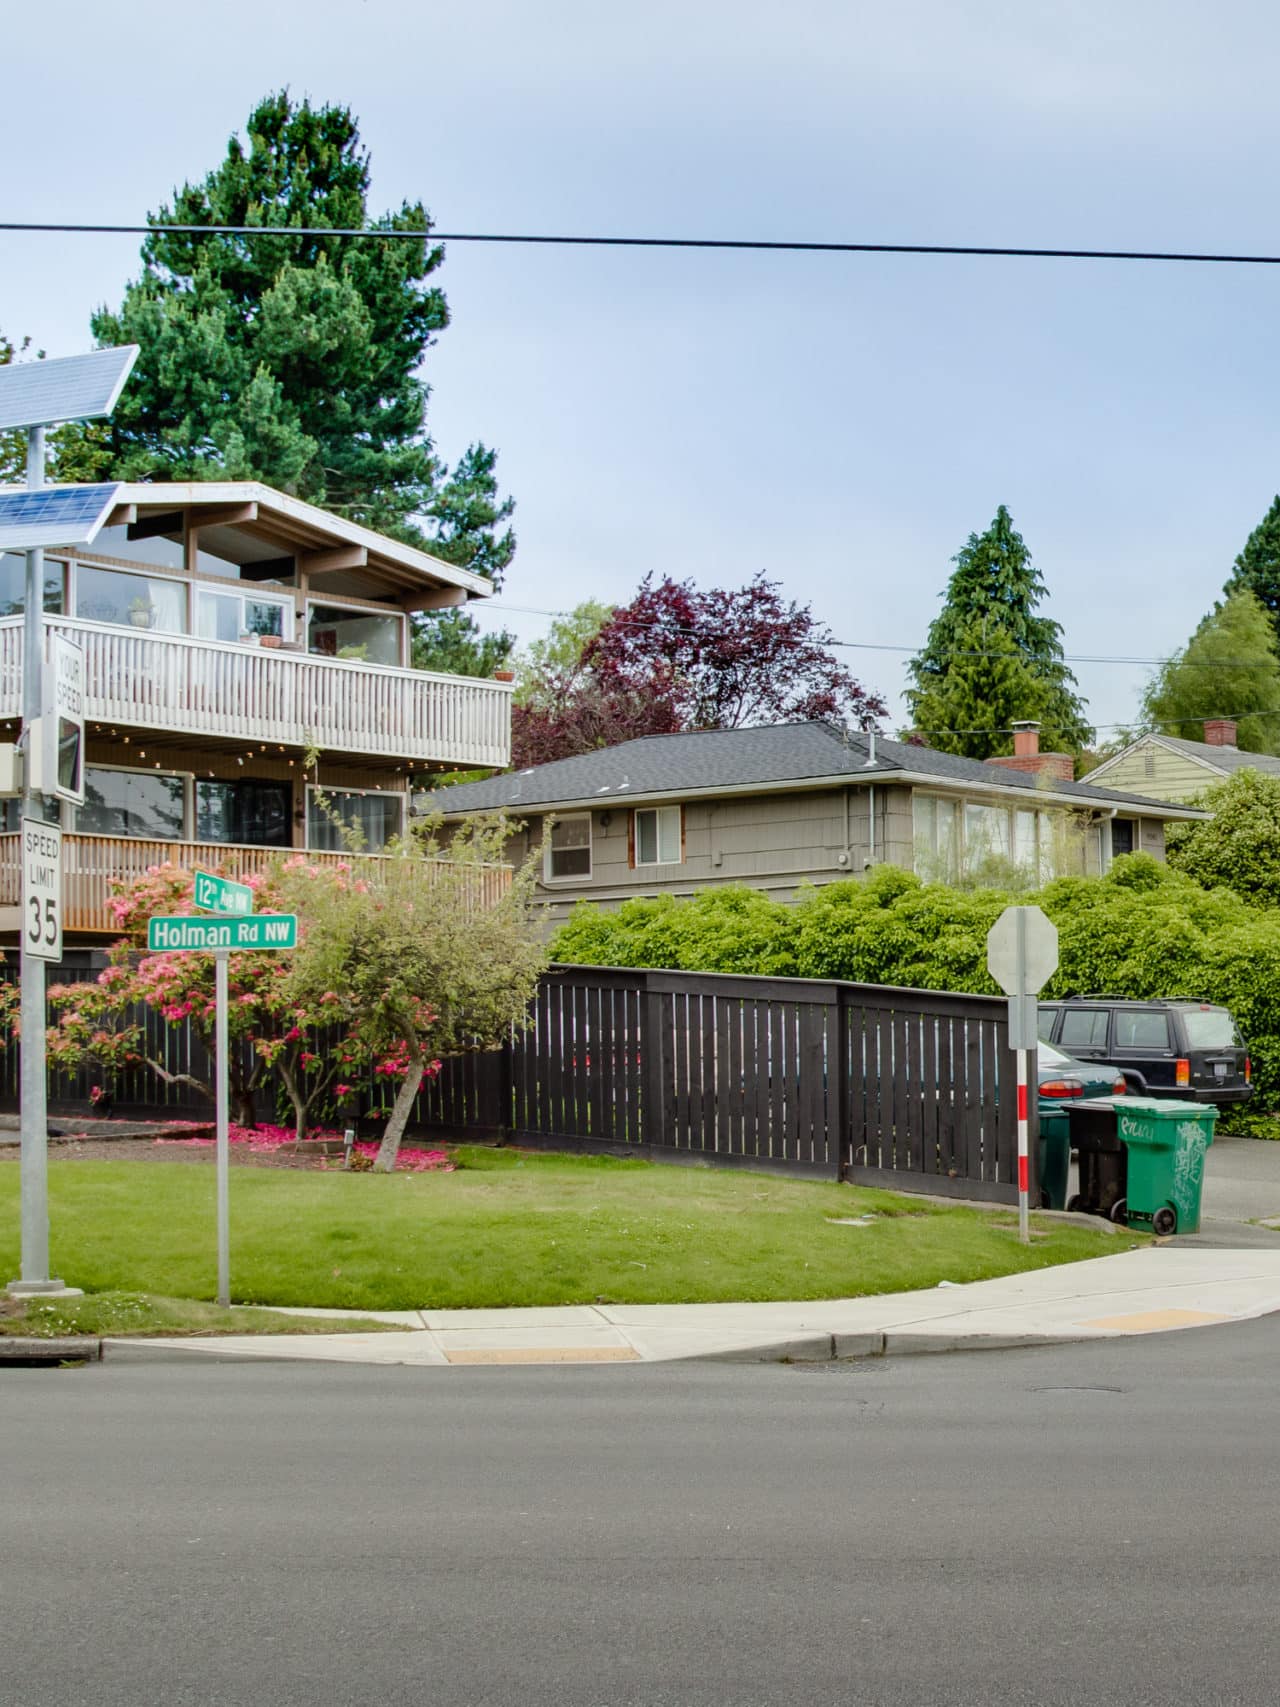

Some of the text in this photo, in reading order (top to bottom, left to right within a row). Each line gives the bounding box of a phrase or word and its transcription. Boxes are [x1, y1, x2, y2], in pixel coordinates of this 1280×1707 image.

[60, 653, 80, 684] YOUR
[57, 681, 80, 714] SPEED
[26, 832, 59, 858] SPEED
[30, 864, 55, 888] LIMIT
[220, 887, 234, 908] Ave
[29, 896, 57, 945] 35
[154, 922, 290, 946] Holman Rd NW
